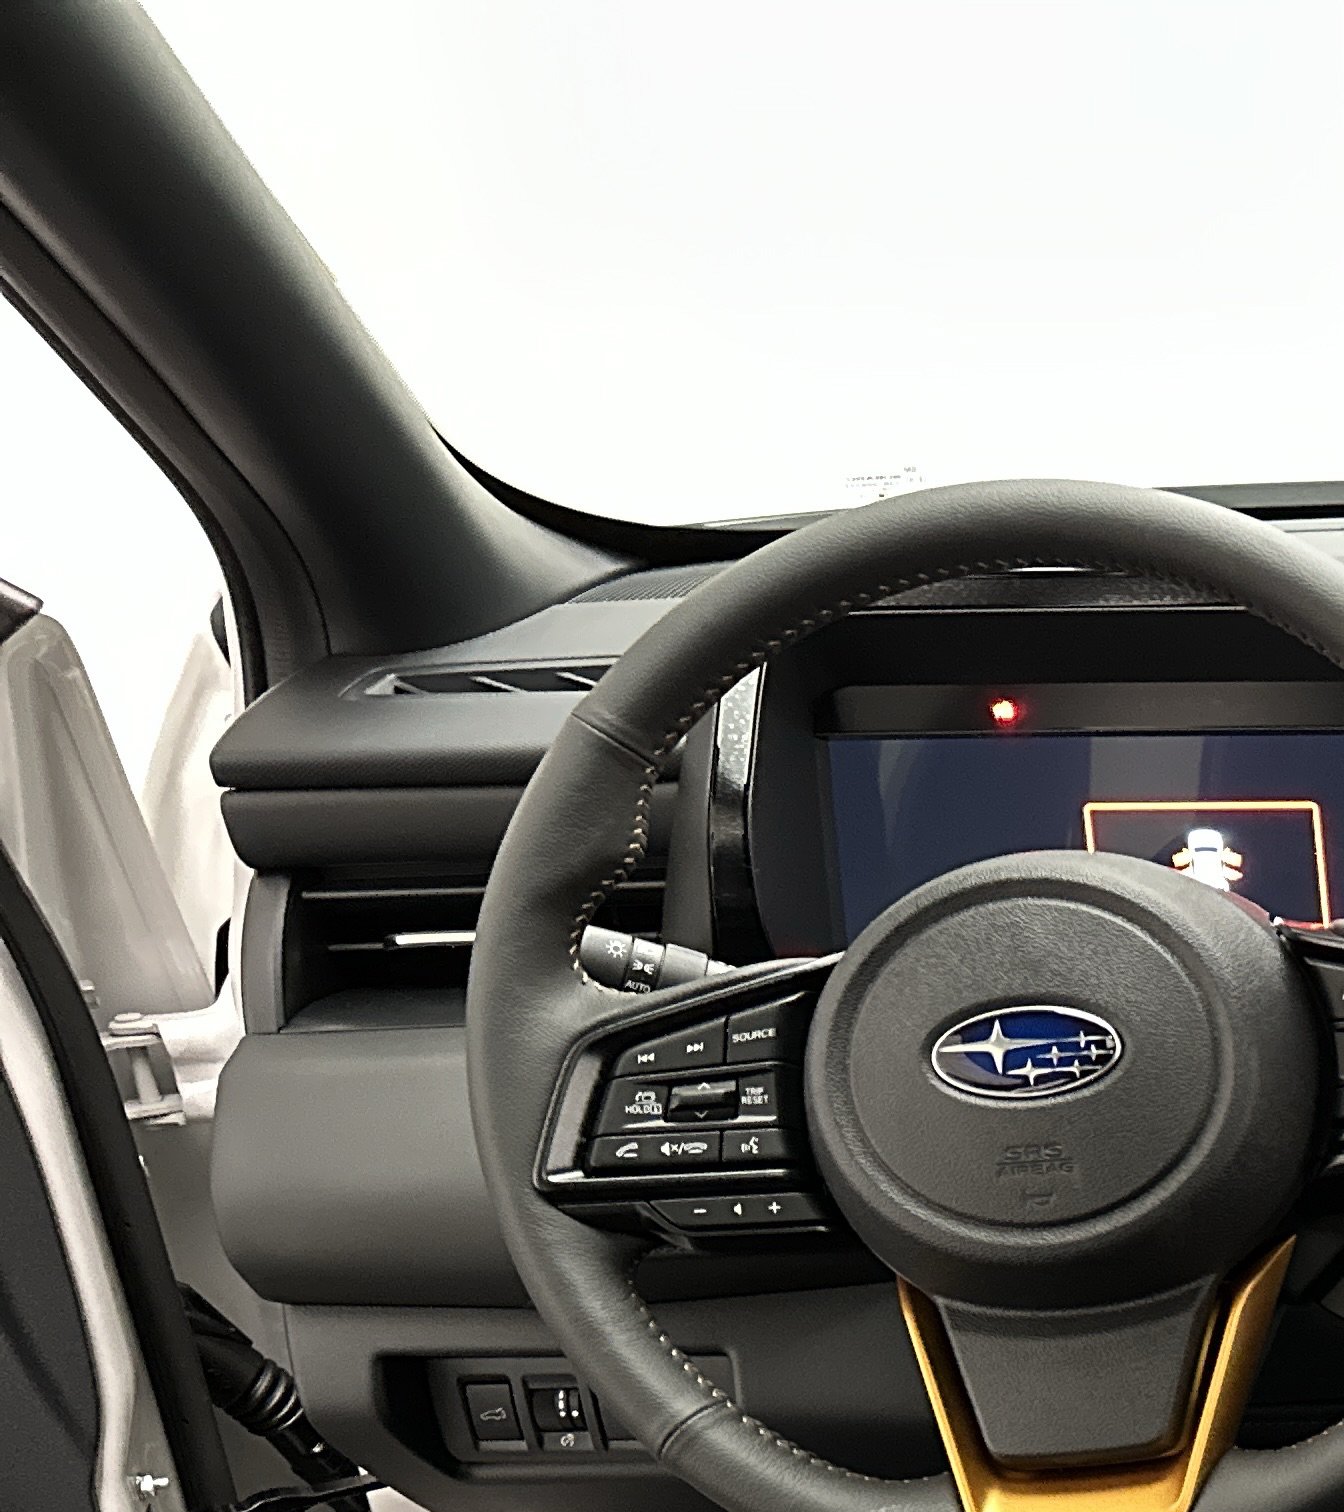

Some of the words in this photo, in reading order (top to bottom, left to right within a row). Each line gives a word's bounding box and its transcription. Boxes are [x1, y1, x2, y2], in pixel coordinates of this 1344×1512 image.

[624, 979, 651, 993] AUTO
[732, 1027, 777, 1043] SOURCE
[745, 1086, 764, 1096] TRIP
[741, 1094, 769, 1105] RESET
[1004, 1145, 1062, 1161] SRS
